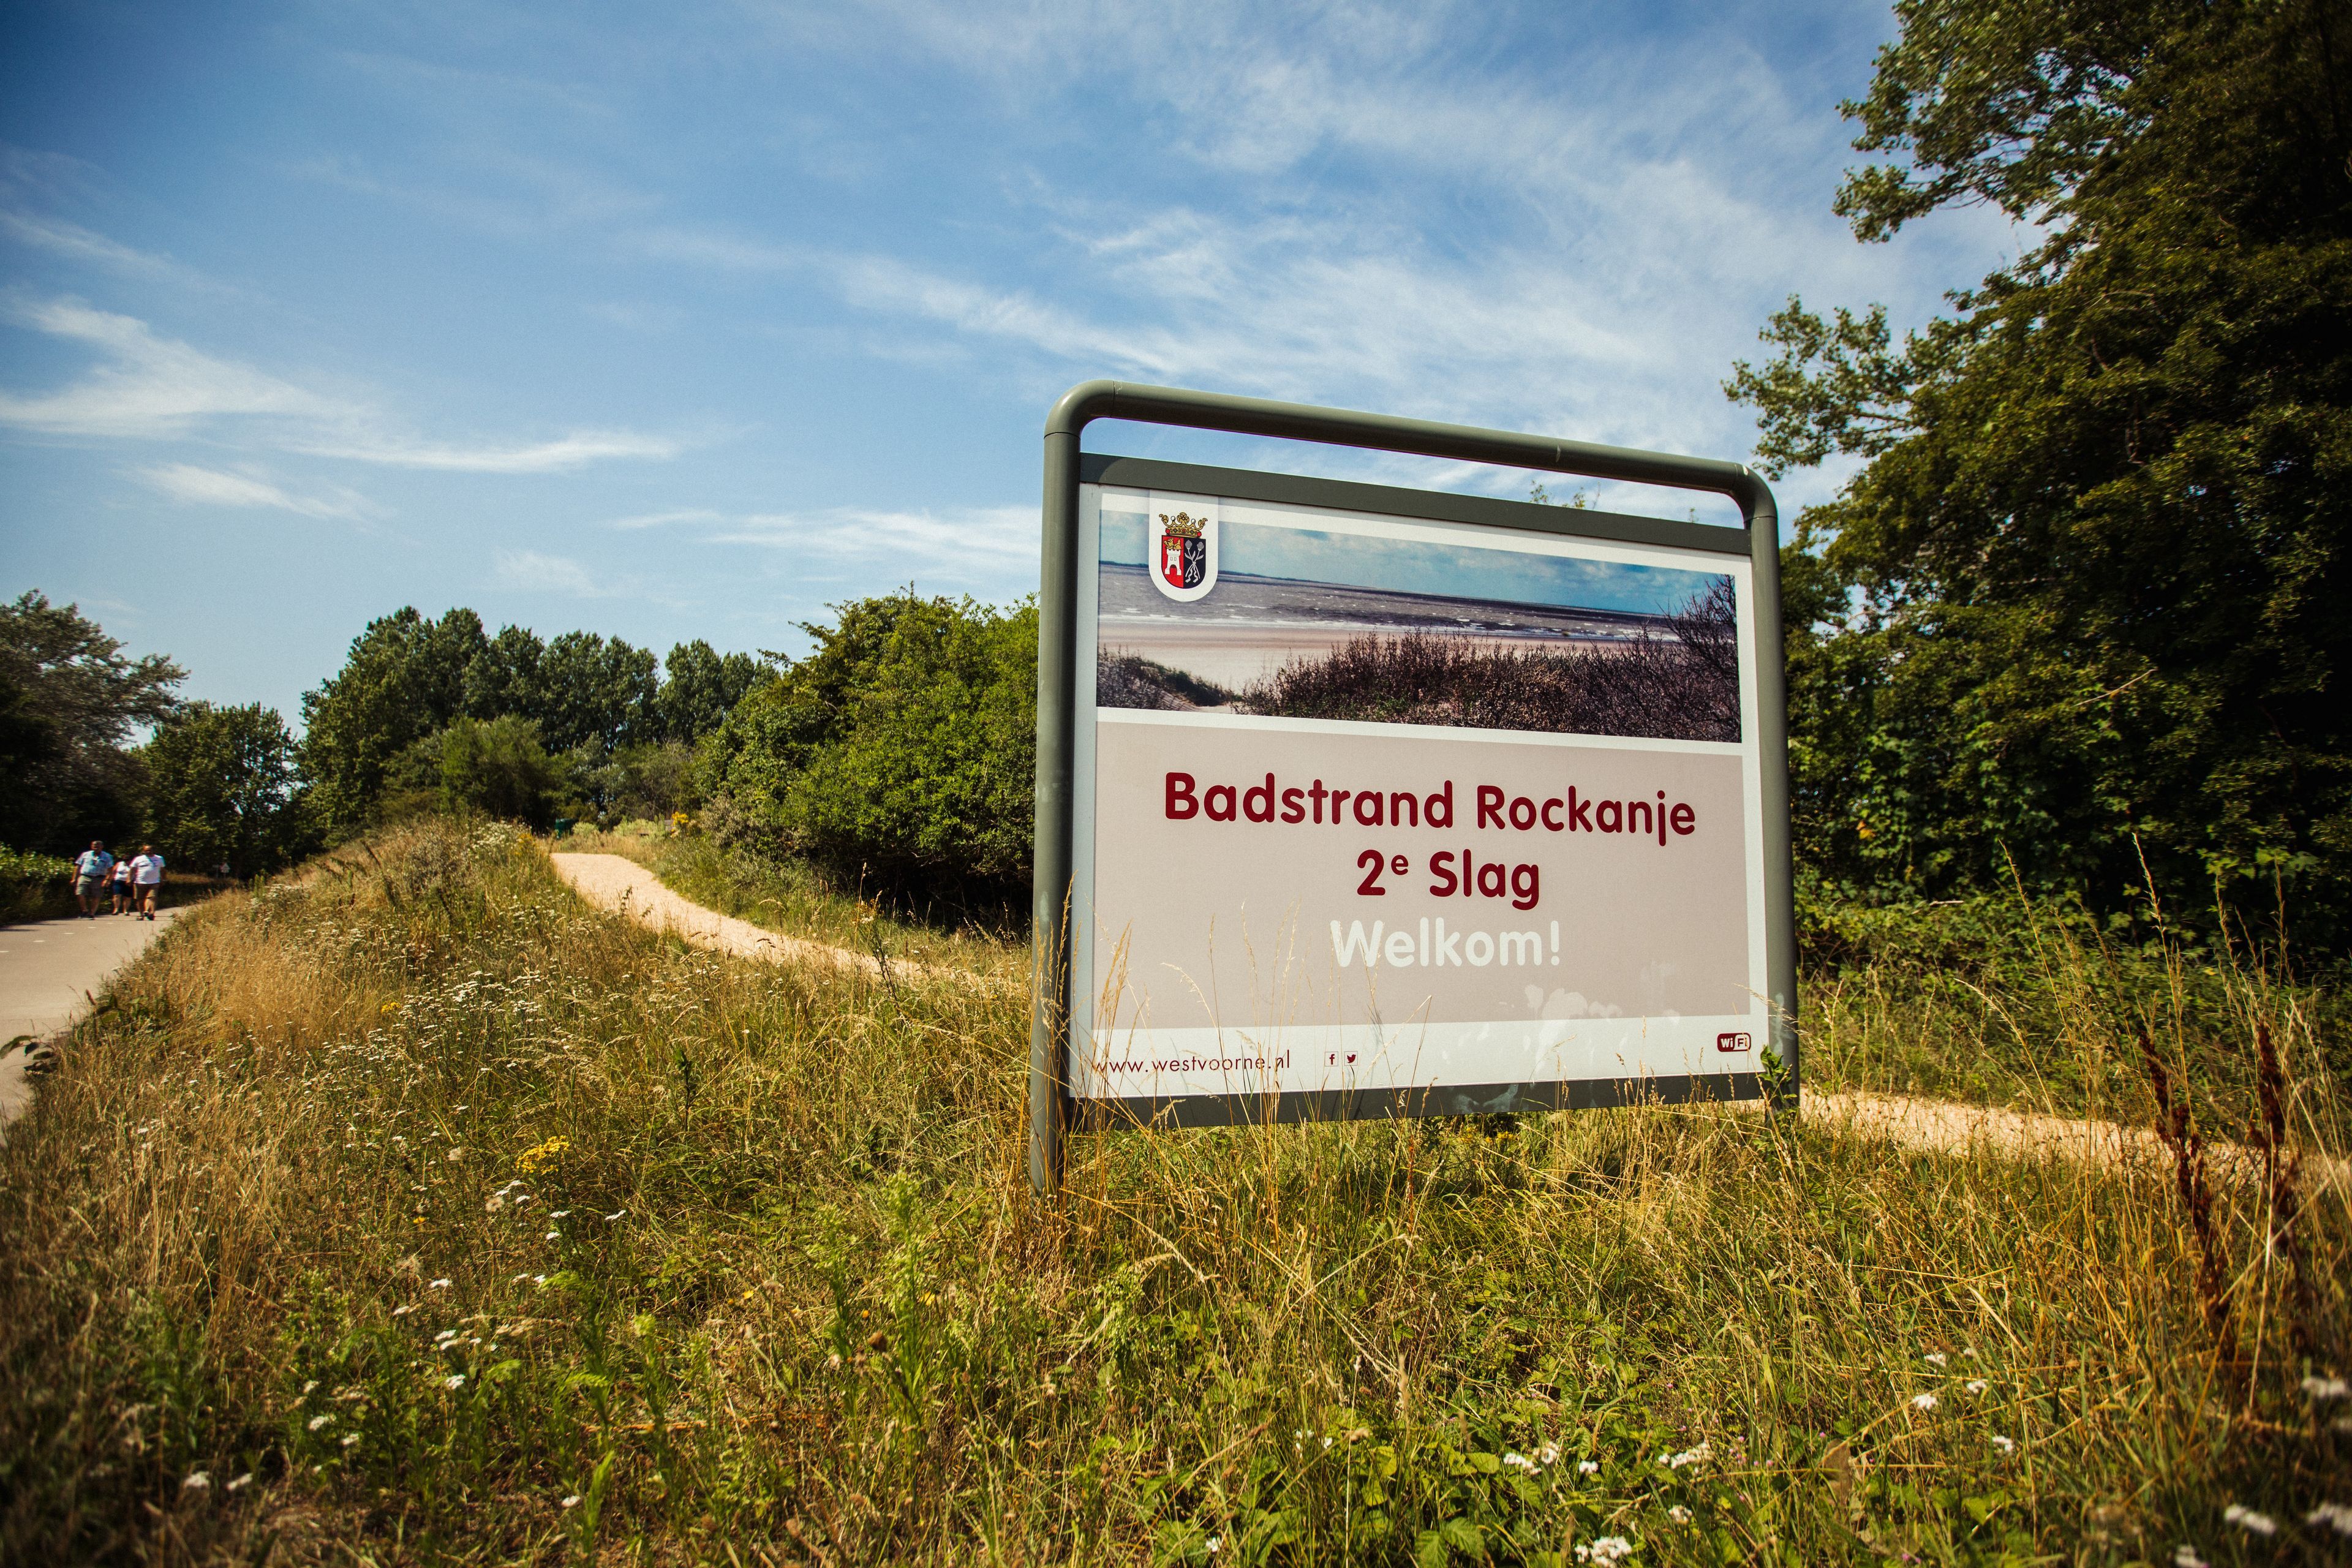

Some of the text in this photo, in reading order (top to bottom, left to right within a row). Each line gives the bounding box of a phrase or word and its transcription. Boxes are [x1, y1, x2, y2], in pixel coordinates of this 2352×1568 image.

[1165, 772, 1695, 847] Badstrand Rockanje
[1429, 848, 1539, 911] Slag
[1330, 918, 1561, 968] Welkom!
[1093, 1049, 1289, 1073] www.westvoorne.nl
